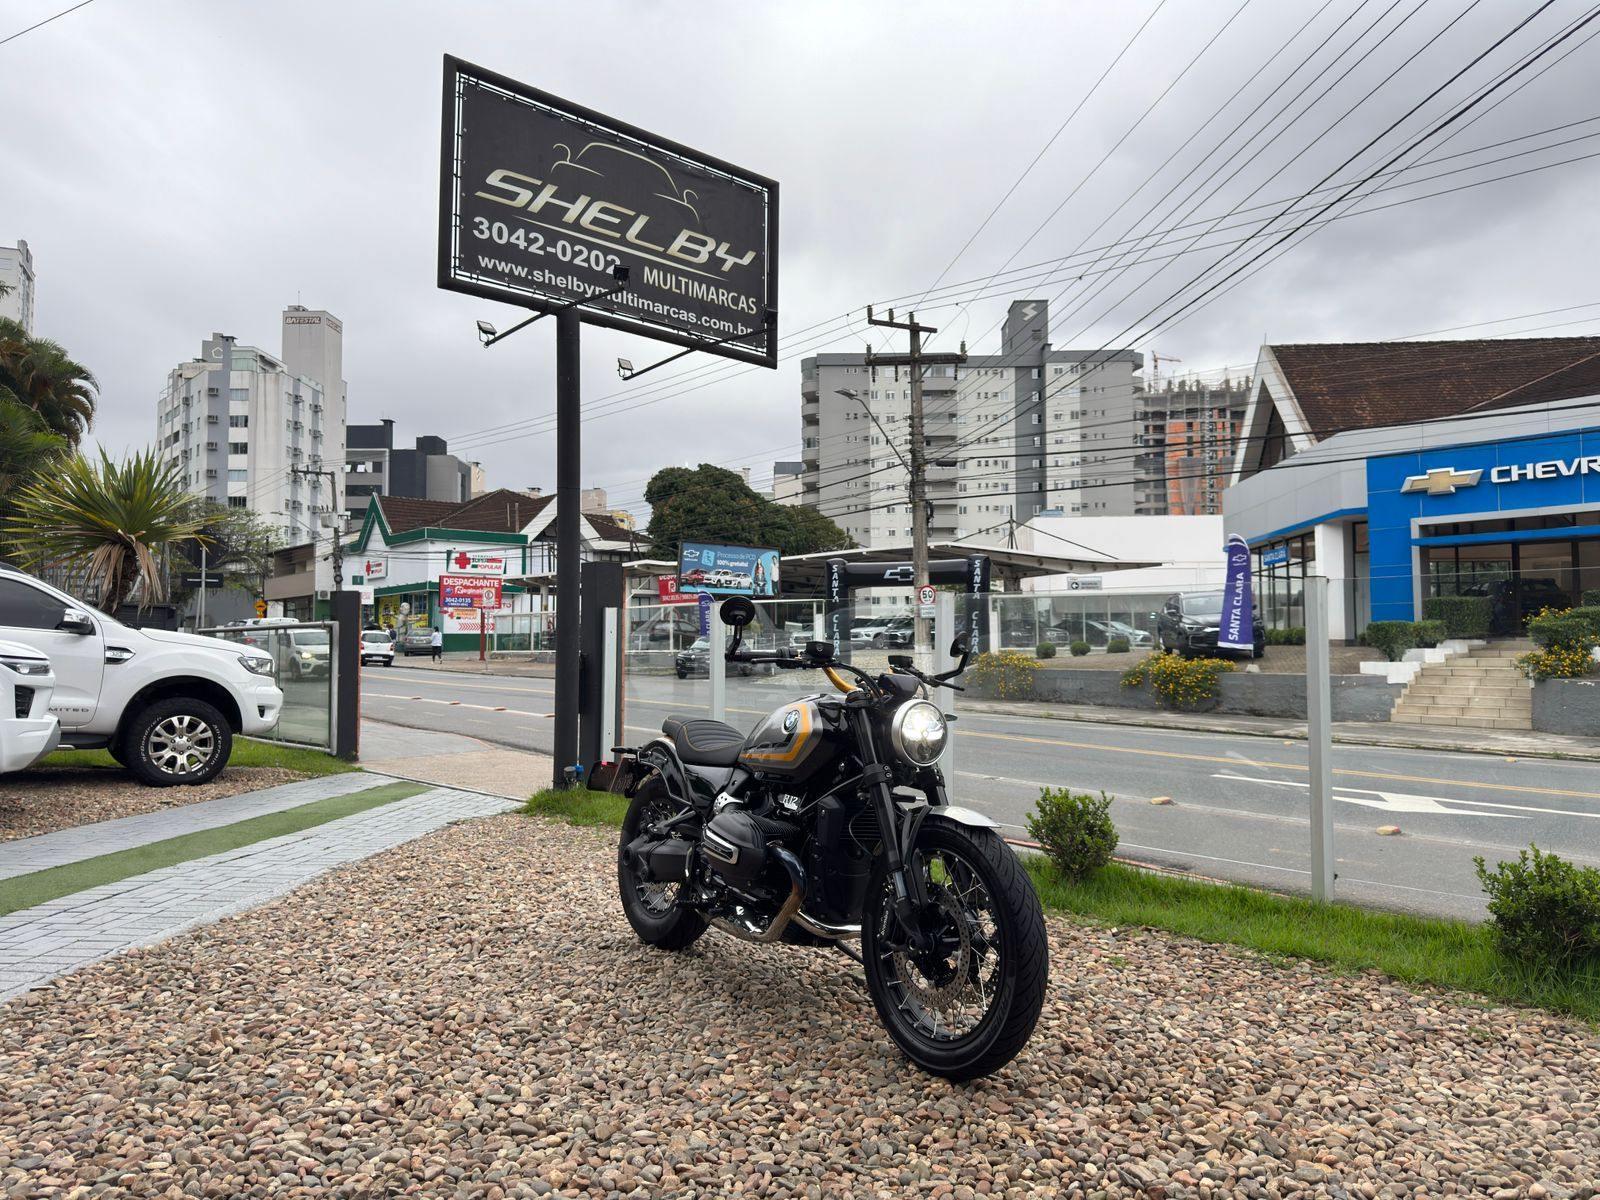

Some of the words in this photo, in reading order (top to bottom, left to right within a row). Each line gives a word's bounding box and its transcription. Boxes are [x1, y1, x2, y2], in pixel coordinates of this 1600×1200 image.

[474, 168, 757, 272] SHELBY
[472, 215, 621, 275] 3042-0202
[643, 265, 757, 315] MULTIMARCAS
[1490, 455, 1600, 484] CHEVR
[443, 577, 500, 588] DESPACHANTE
[831, 564, 839, 603] SANTA
[922, 590, 933, 599] 50
[973, 559, 981, 600] SANTA
[1233, 572, 1244, 606] CLARA
[832, 614, 841, 656] CLARA
[971, 611, 980, 654] CLARA
[1228, 608, 1241, 641] SANTA
